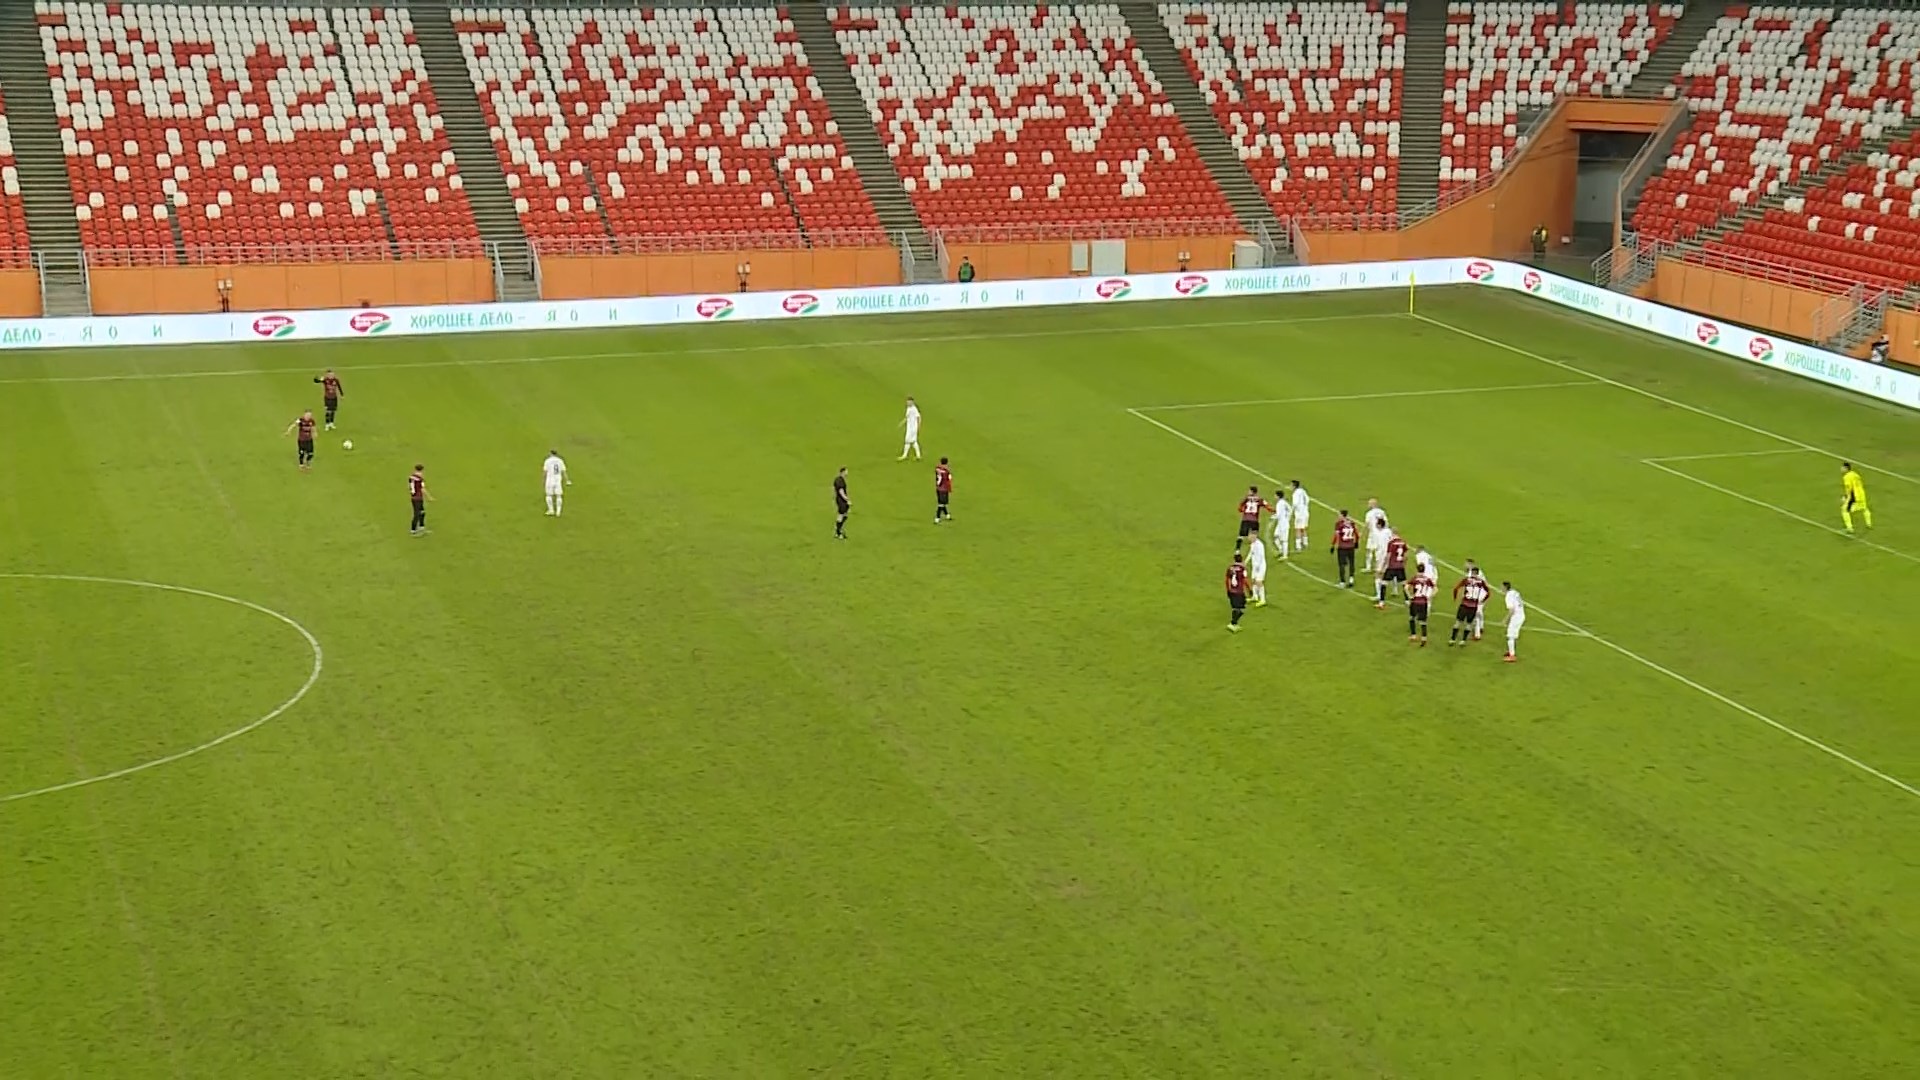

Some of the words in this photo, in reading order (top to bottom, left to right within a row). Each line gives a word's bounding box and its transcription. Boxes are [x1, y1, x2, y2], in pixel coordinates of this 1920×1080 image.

[1224, 275, 1278, 291] ХОРОШЕЕ
[1282, 273, 1311, 289] ДЕЛО
[836, 294, 894, 310] ХОРОШЕЕ
[899, 292, 930, 307] ДЕЛО
[410, 312, 474, 329] ХОРОШЕЕ
[479, 311, 513, 326] ДЕЛО
[3, 327, 42, 343] ДЕЛО
[1784, 350, 1826, 375] ХОРОШЕЕ
[1828, 362, 1852, 382] ДЕЛО
